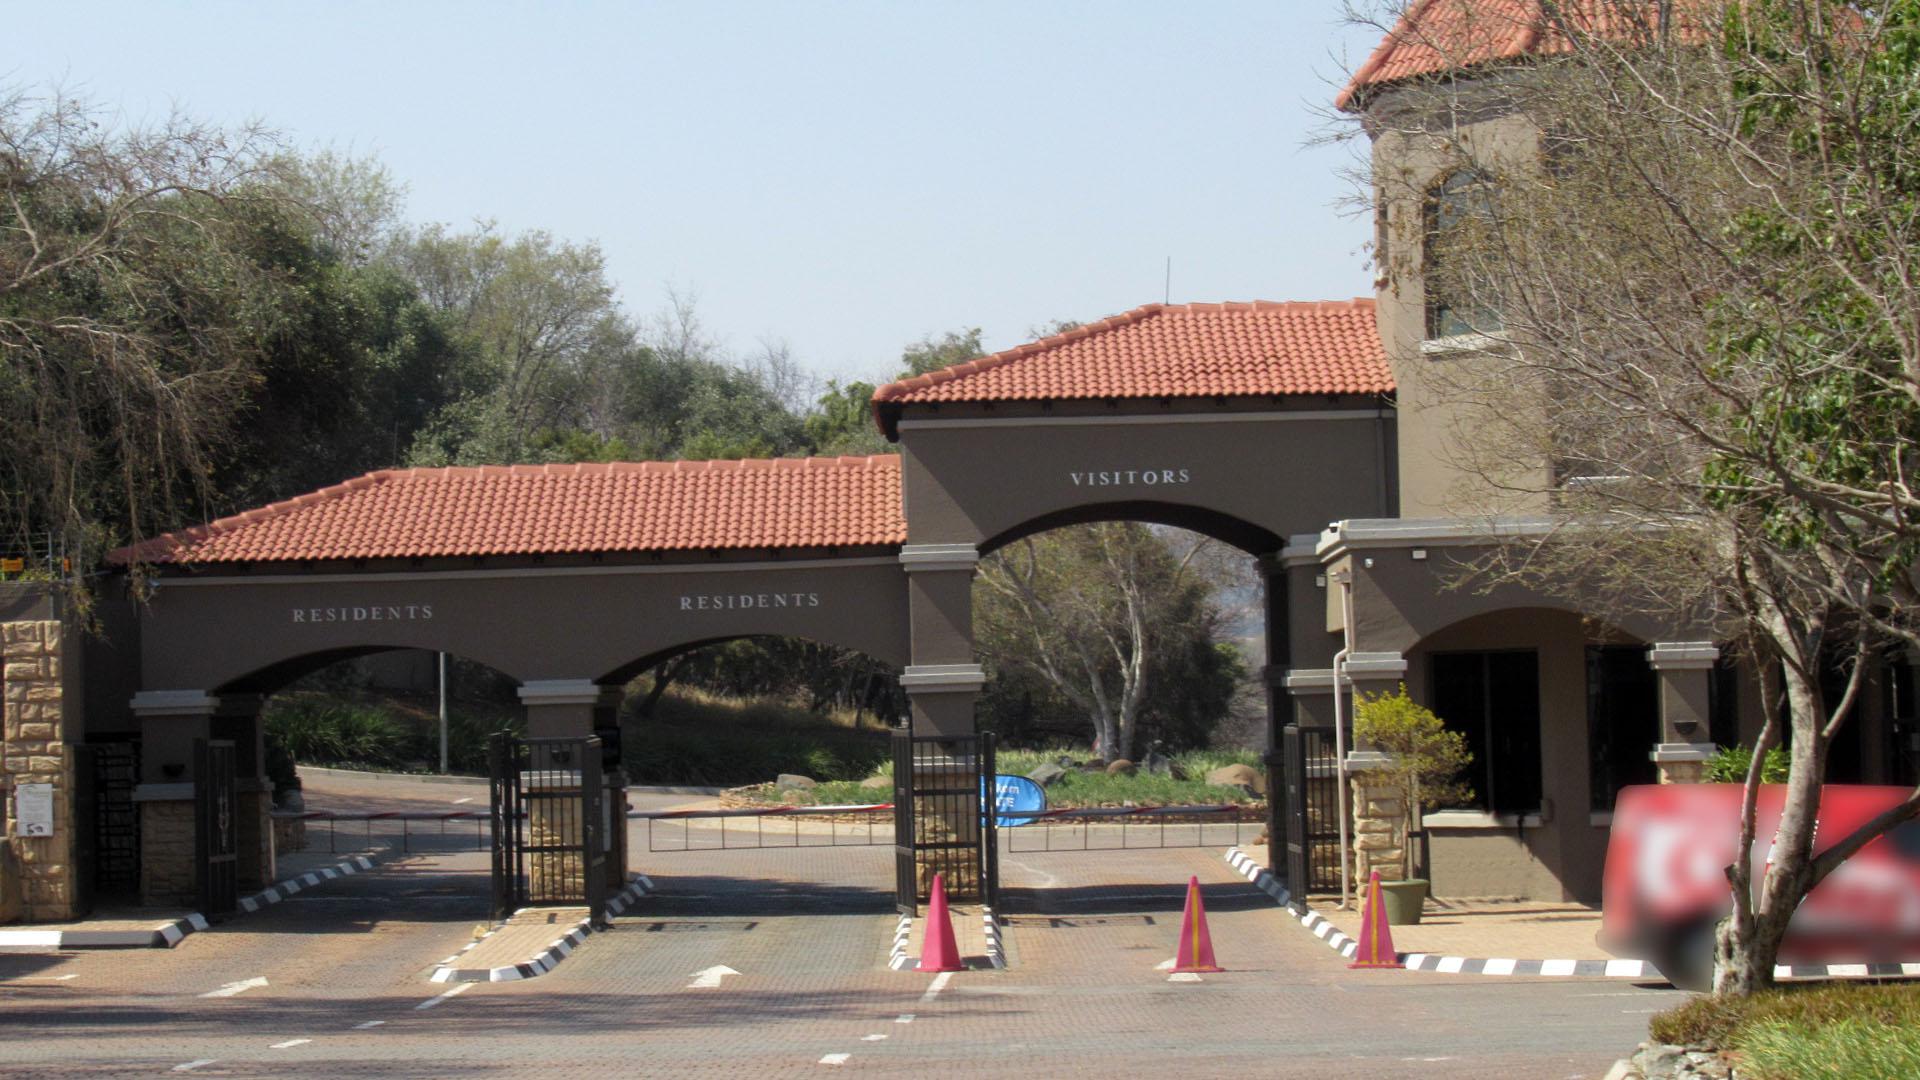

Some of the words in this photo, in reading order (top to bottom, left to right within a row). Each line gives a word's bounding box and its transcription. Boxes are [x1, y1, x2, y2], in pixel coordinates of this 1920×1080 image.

[1070, 469, 1190, 487] VISITORS
[679, 592, 820, 610] RESIDENTS
[292, 604, 434, 623] RESIDENTS
